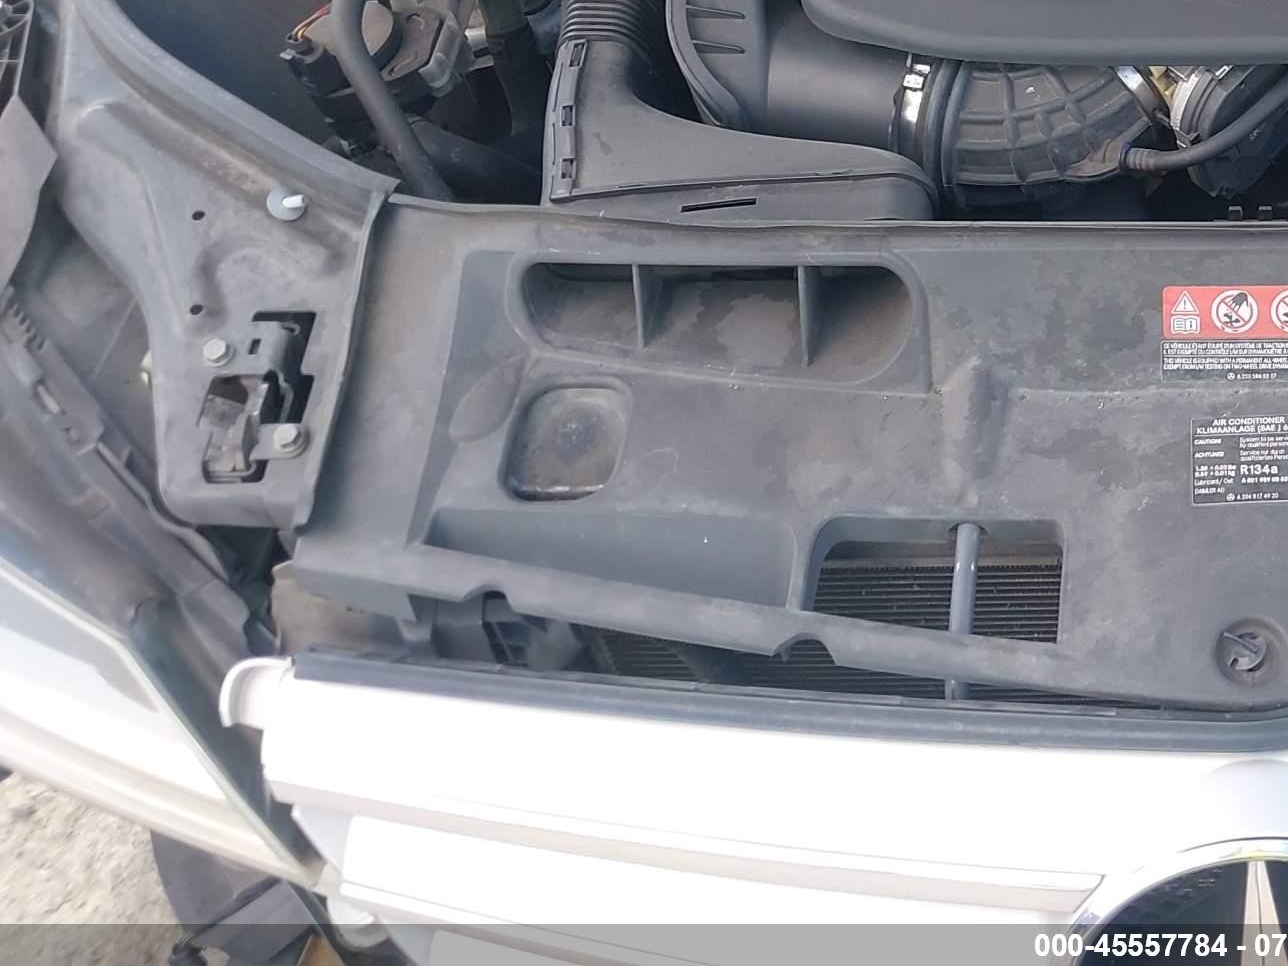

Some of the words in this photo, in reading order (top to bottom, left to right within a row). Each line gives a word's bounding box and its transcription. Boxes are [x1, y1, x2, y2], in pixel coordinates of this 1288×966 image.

[1213, 418, 1227, 426] AIR
[1228, 416, 1285, 425] CONDITIONER
[1196, 425, 1255, 434] KLIMAANLAGE
[1257, 424, 1276, 433] (SAE
[1240, 464, 1279, 475] R134a
